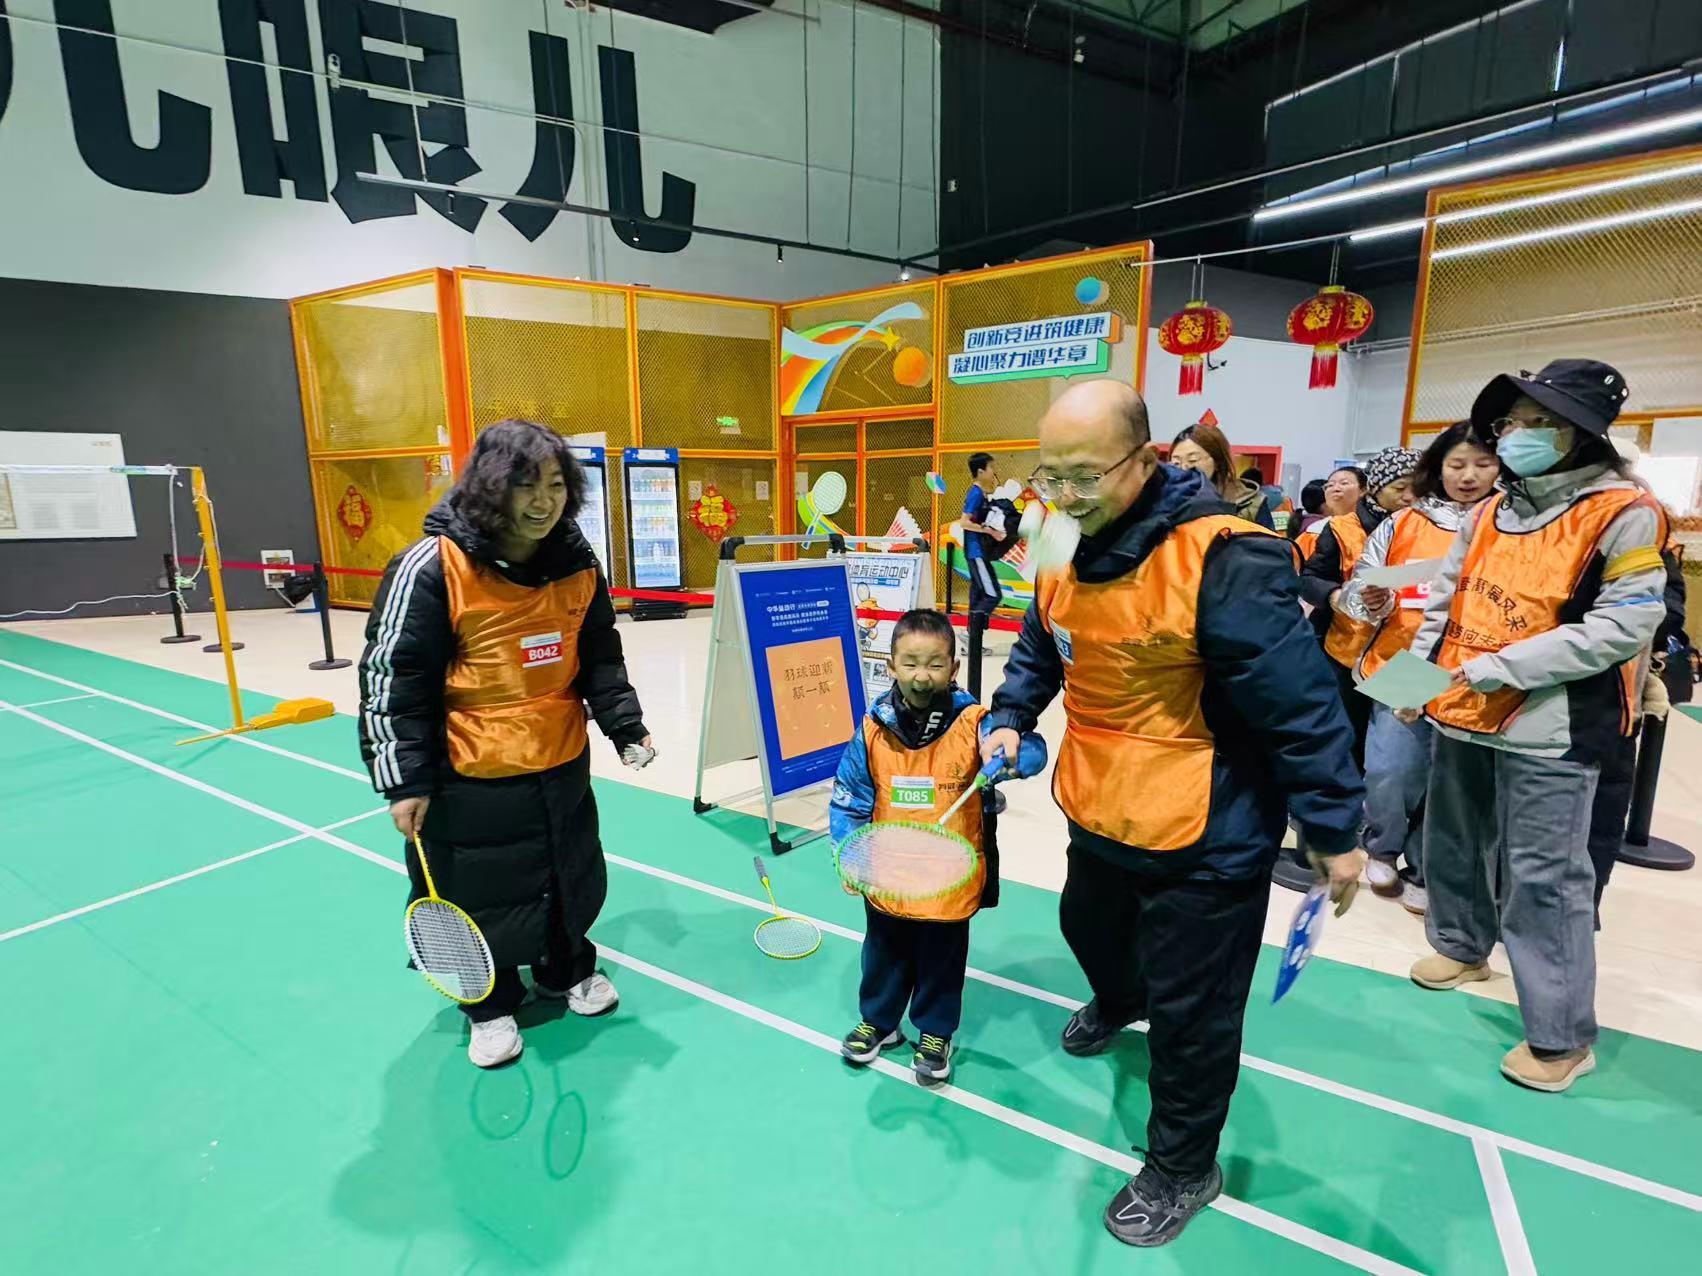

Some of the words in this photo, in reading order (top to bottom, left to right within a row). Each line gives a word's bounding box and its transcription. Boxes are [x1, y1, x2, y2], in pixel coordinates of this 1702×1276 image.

[953, 344, 1089, 374] 凝心聚力谱华章
[528, 645, 558, 661] B042
[896, 789, 929, 802] T085
